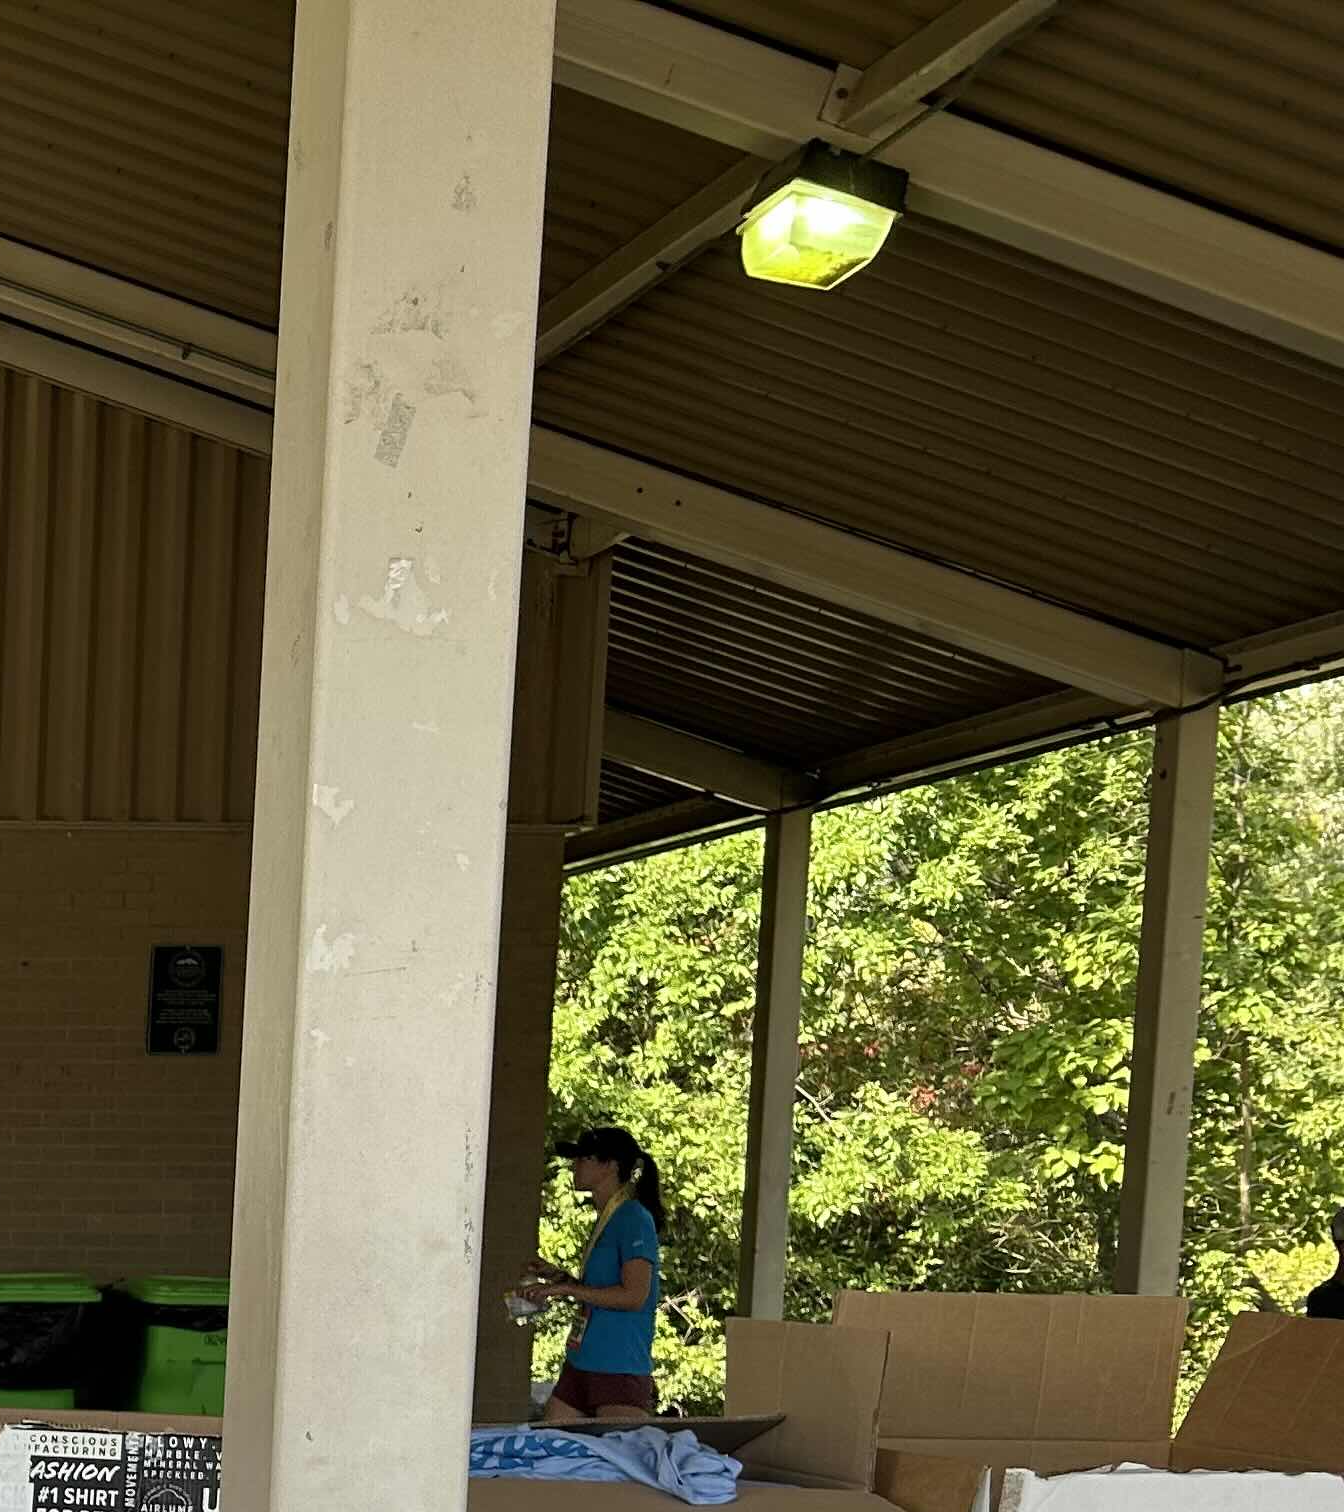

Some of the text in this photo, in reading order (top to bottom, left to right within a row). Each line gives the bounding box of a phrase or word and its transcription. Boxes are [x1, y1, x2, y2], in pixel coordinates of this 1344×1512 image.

[30, 1460, 120, 1482] ASHION
[38, 1486, 119, 1506] #1 SHIRT
